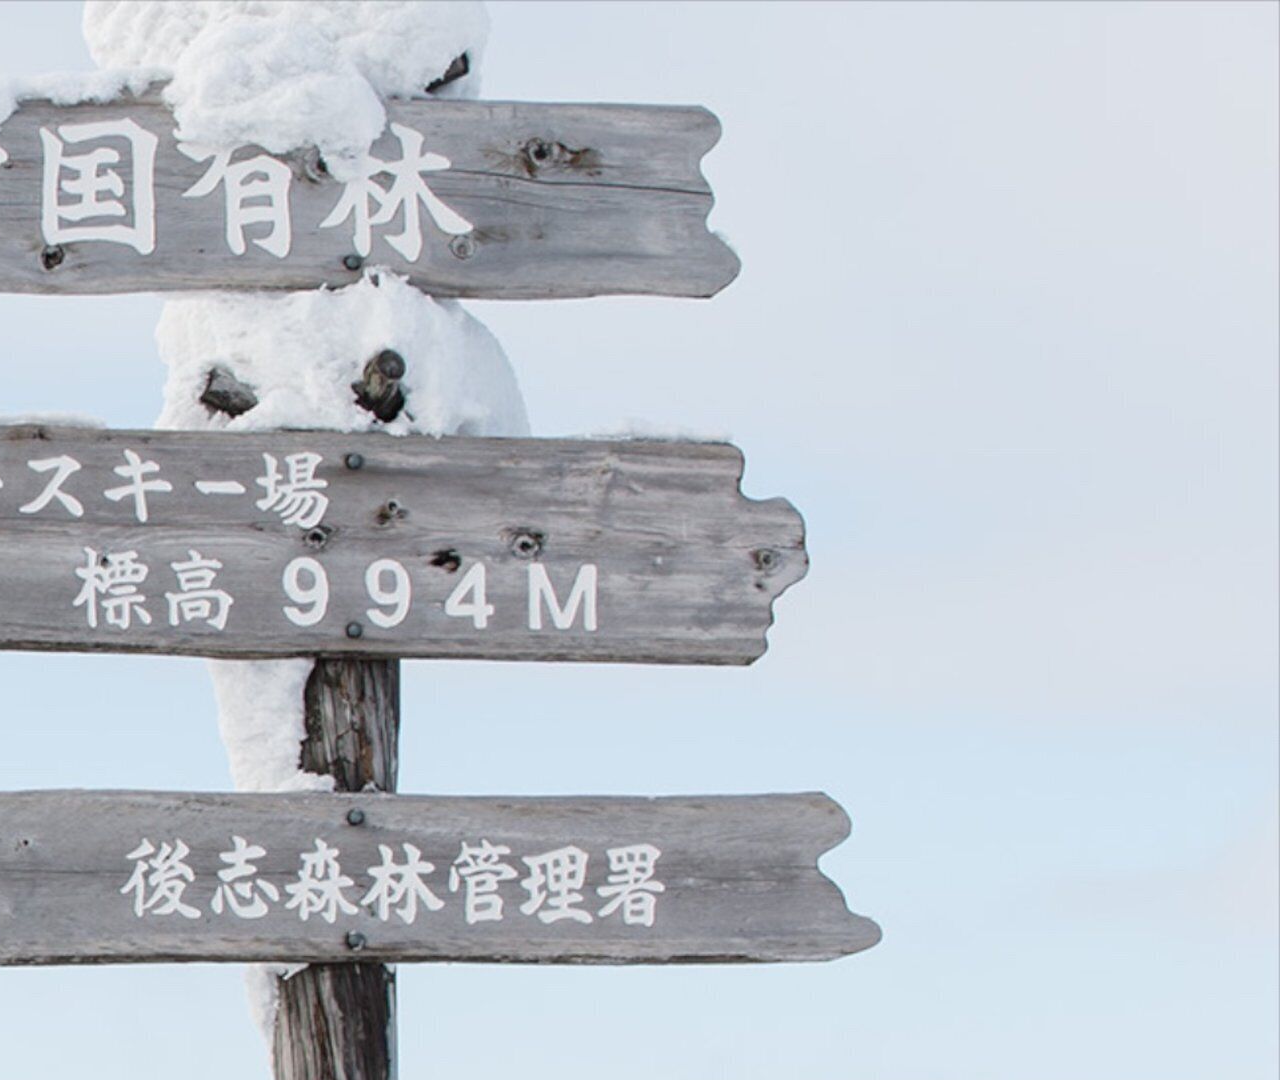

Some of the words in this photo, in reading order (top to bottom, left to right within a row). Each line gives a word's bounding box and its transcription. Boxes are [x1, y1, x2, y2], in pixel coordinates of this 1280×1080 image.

[119, 835, 666, 928] 後志森林管理署
